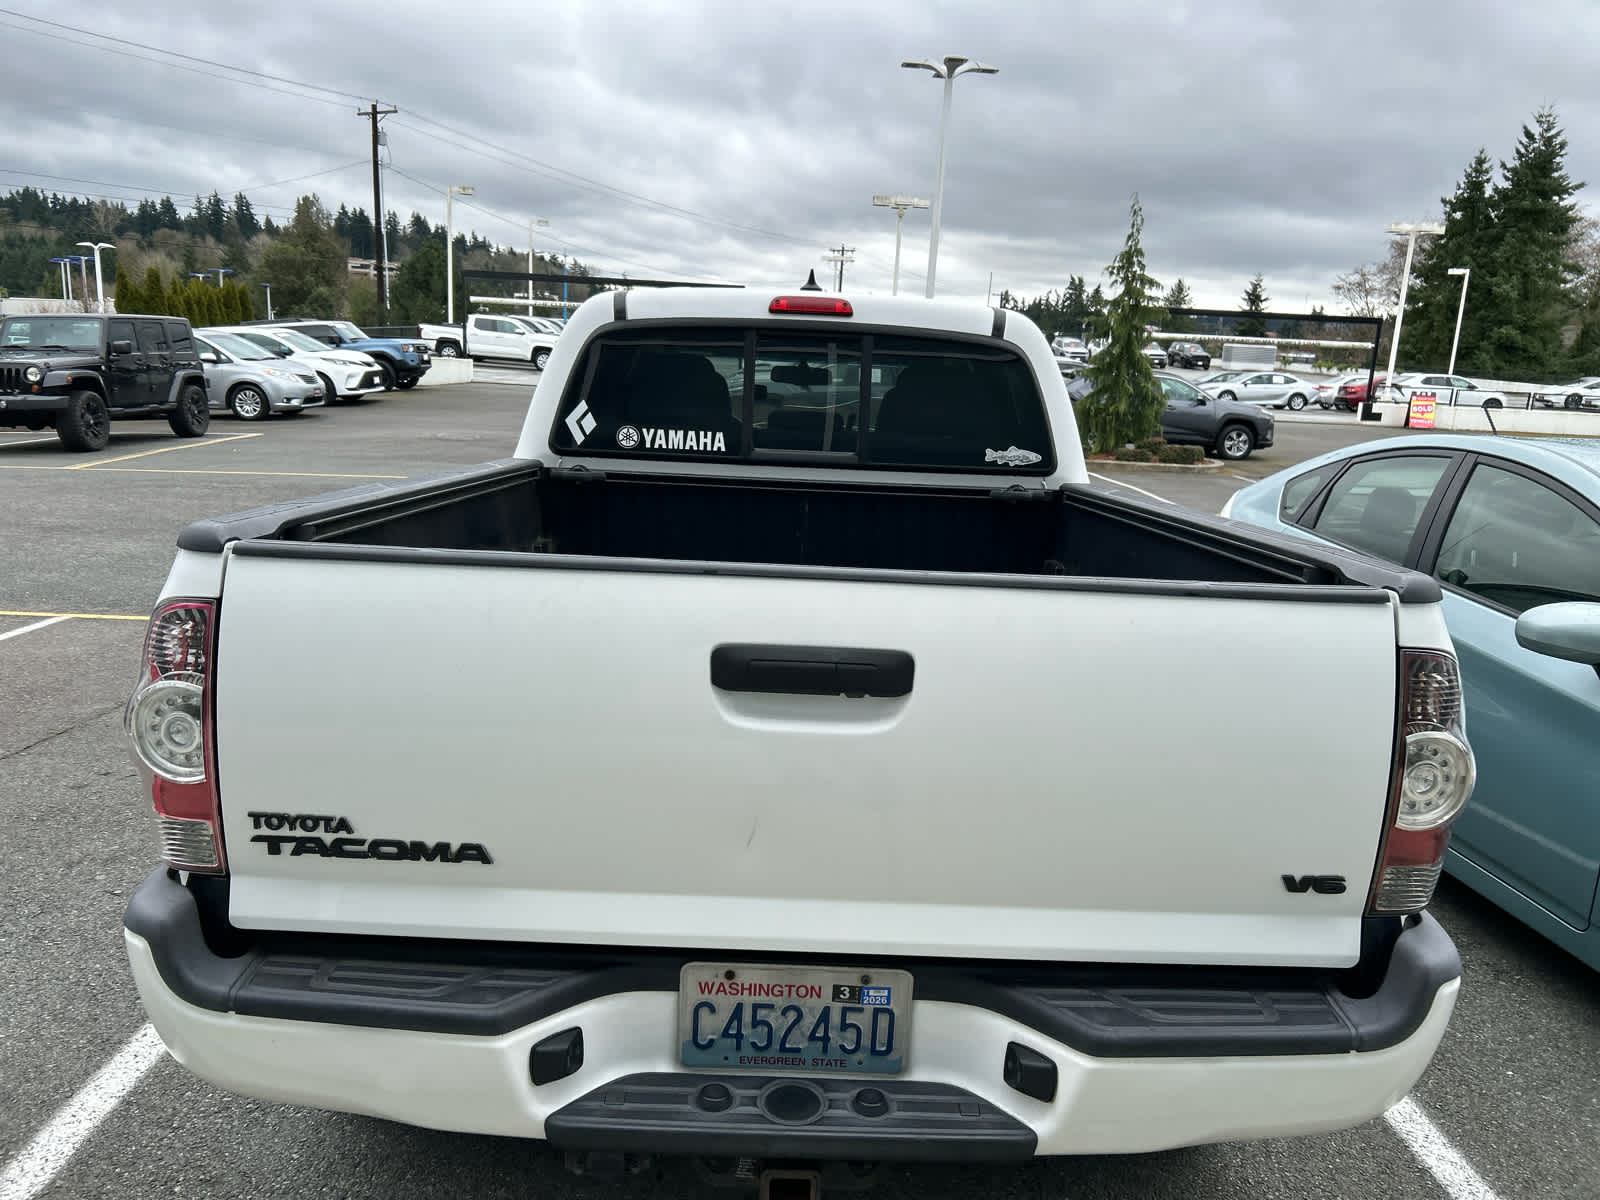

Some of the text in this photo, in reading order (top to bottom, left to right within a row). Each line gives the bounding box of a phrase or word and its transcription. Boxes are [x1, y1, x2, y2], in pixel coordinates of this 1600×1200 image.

[642, 428, 726, 453] YAMAHA
[248, 811, 354, 834] TOYOTA
[250, 835, 494, 864] TACOMA
[1281, 874, 1347, 894] V6
[698, 981, 822, 999] WASHINGTON
[838, 986, 850, 999] 3
[863, 995, 888, 1005] 2026
[691, 1001, 896, 1056] C45245D
[738, 1055, 848, 1068] EVERGREEN STATE
